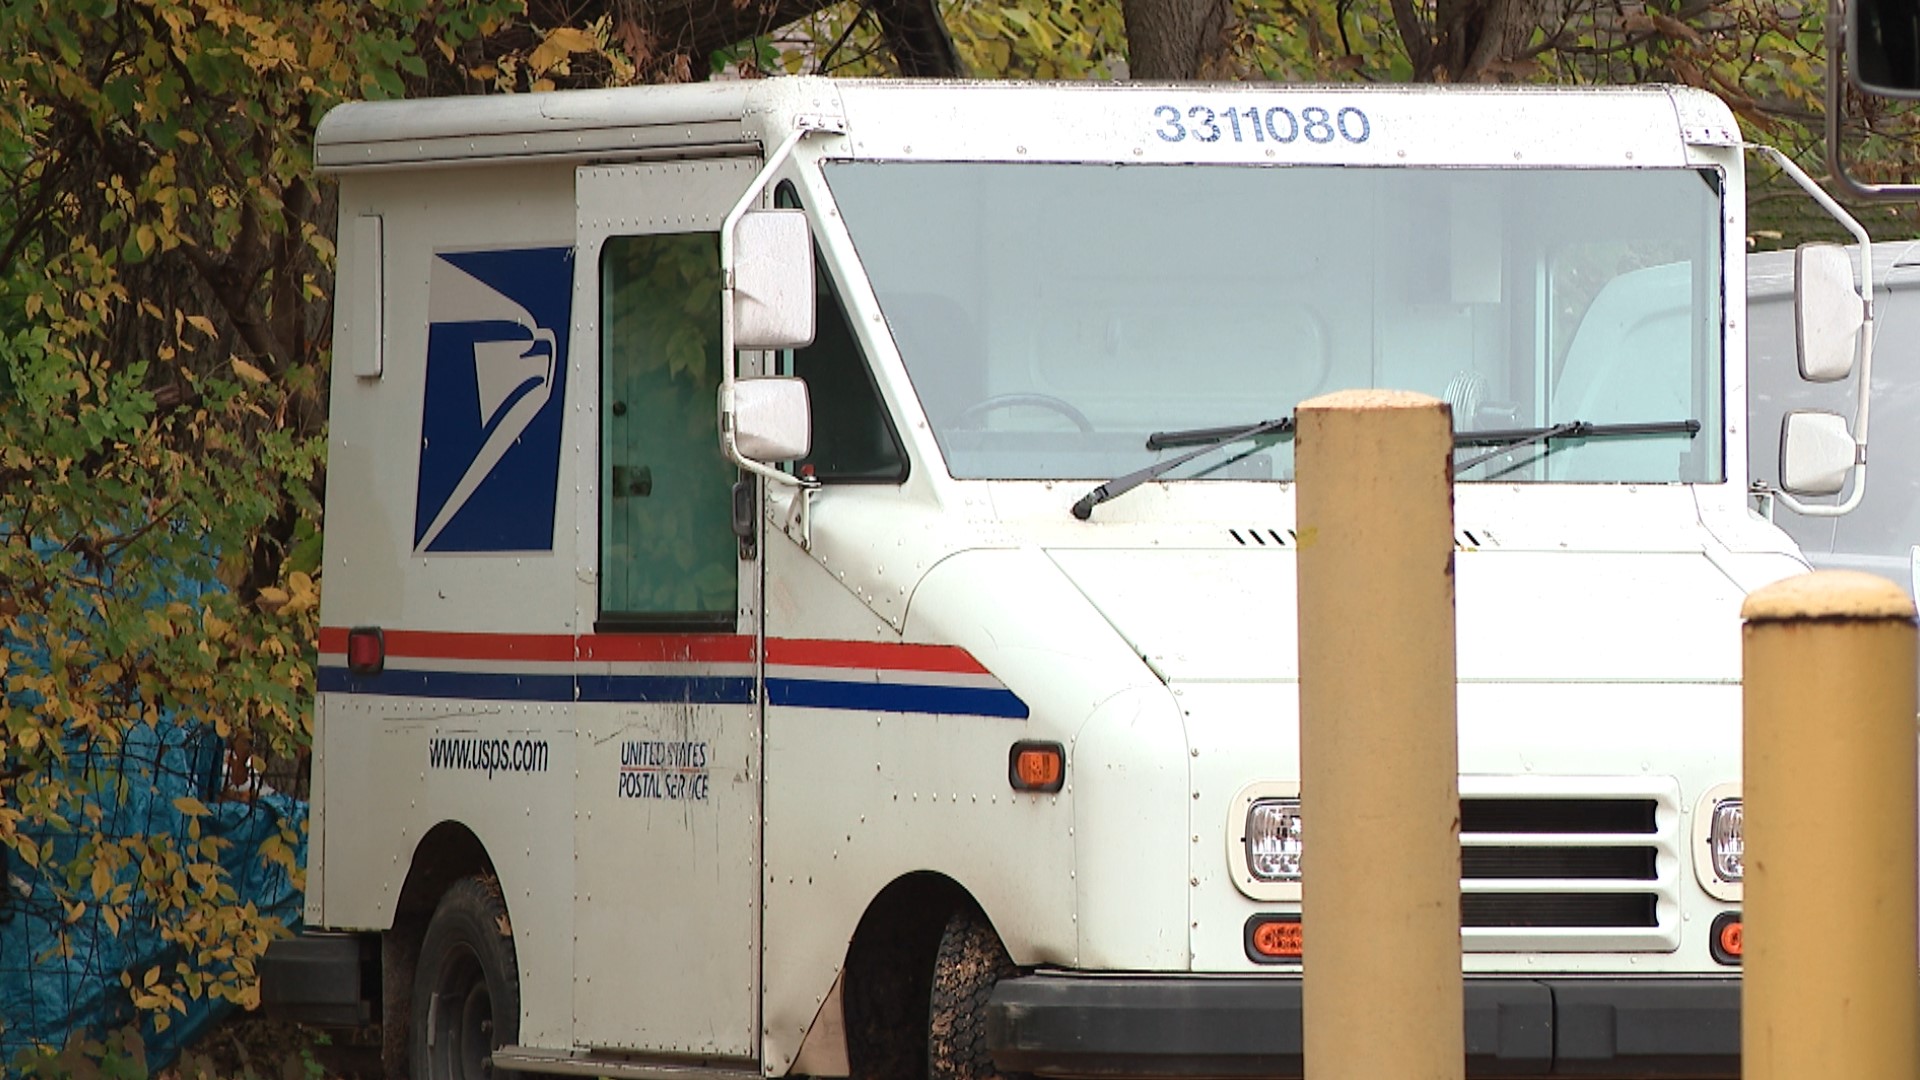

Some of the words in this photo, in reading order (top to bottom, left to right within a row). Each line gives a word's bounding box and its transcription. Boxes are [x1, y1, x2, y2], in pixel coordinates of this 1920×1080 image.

[1153, 104, 1371, 144] 3311080
[429, 738, 549, 780] www.usps.com
[620, 741, 665, 767] UNITED
[667, 741, 707, 768] STATES
[618, 772, 662, 798] POSTAL
